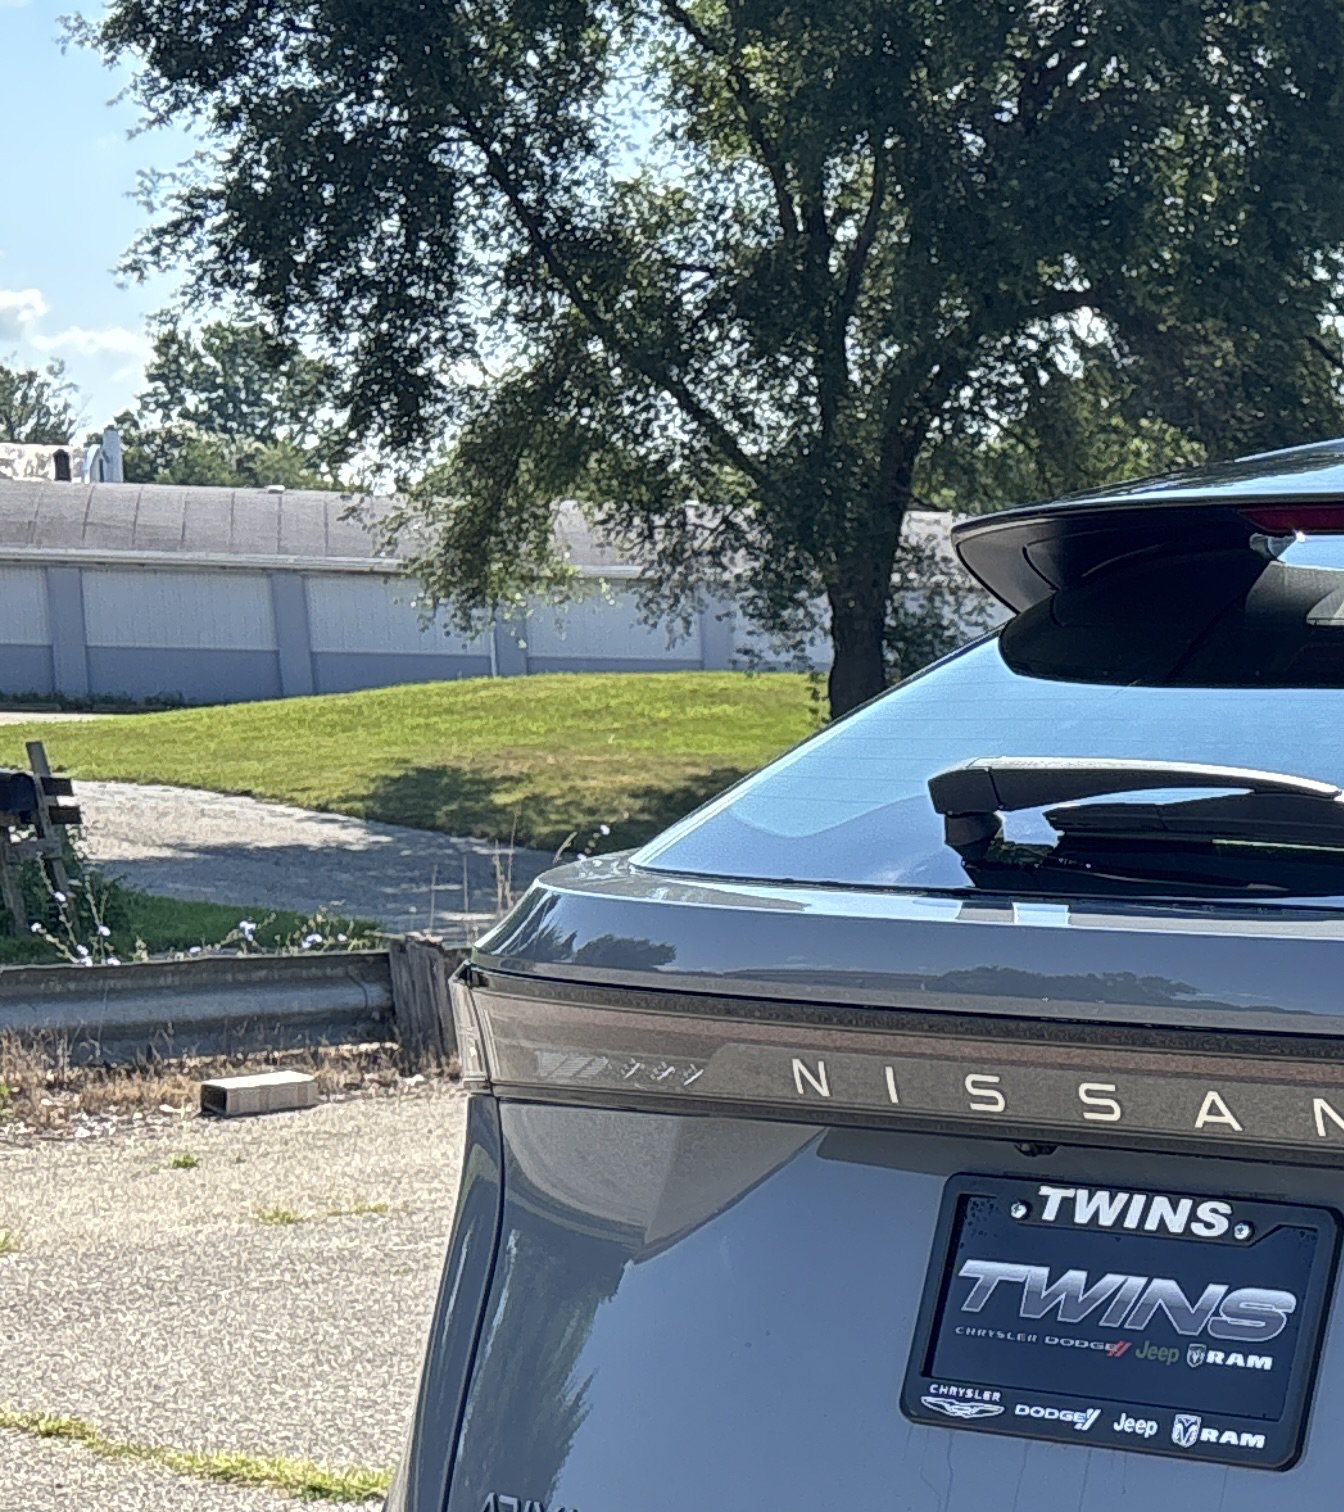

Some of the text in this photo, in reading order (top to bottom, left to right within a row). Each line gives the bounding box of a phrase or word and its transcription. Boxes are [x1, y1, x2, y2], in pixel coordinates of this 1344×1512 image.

[1038, 1185, 1233, 1237] TWINS
[957, 1259, 1297, 1342] TWINS
[954, 1326, 1273, 1371] CHRYSLER DODGE Jeep RAM
[929, 1383, 1266, 1449] CHRYSLER DODGE Jeep RAM
